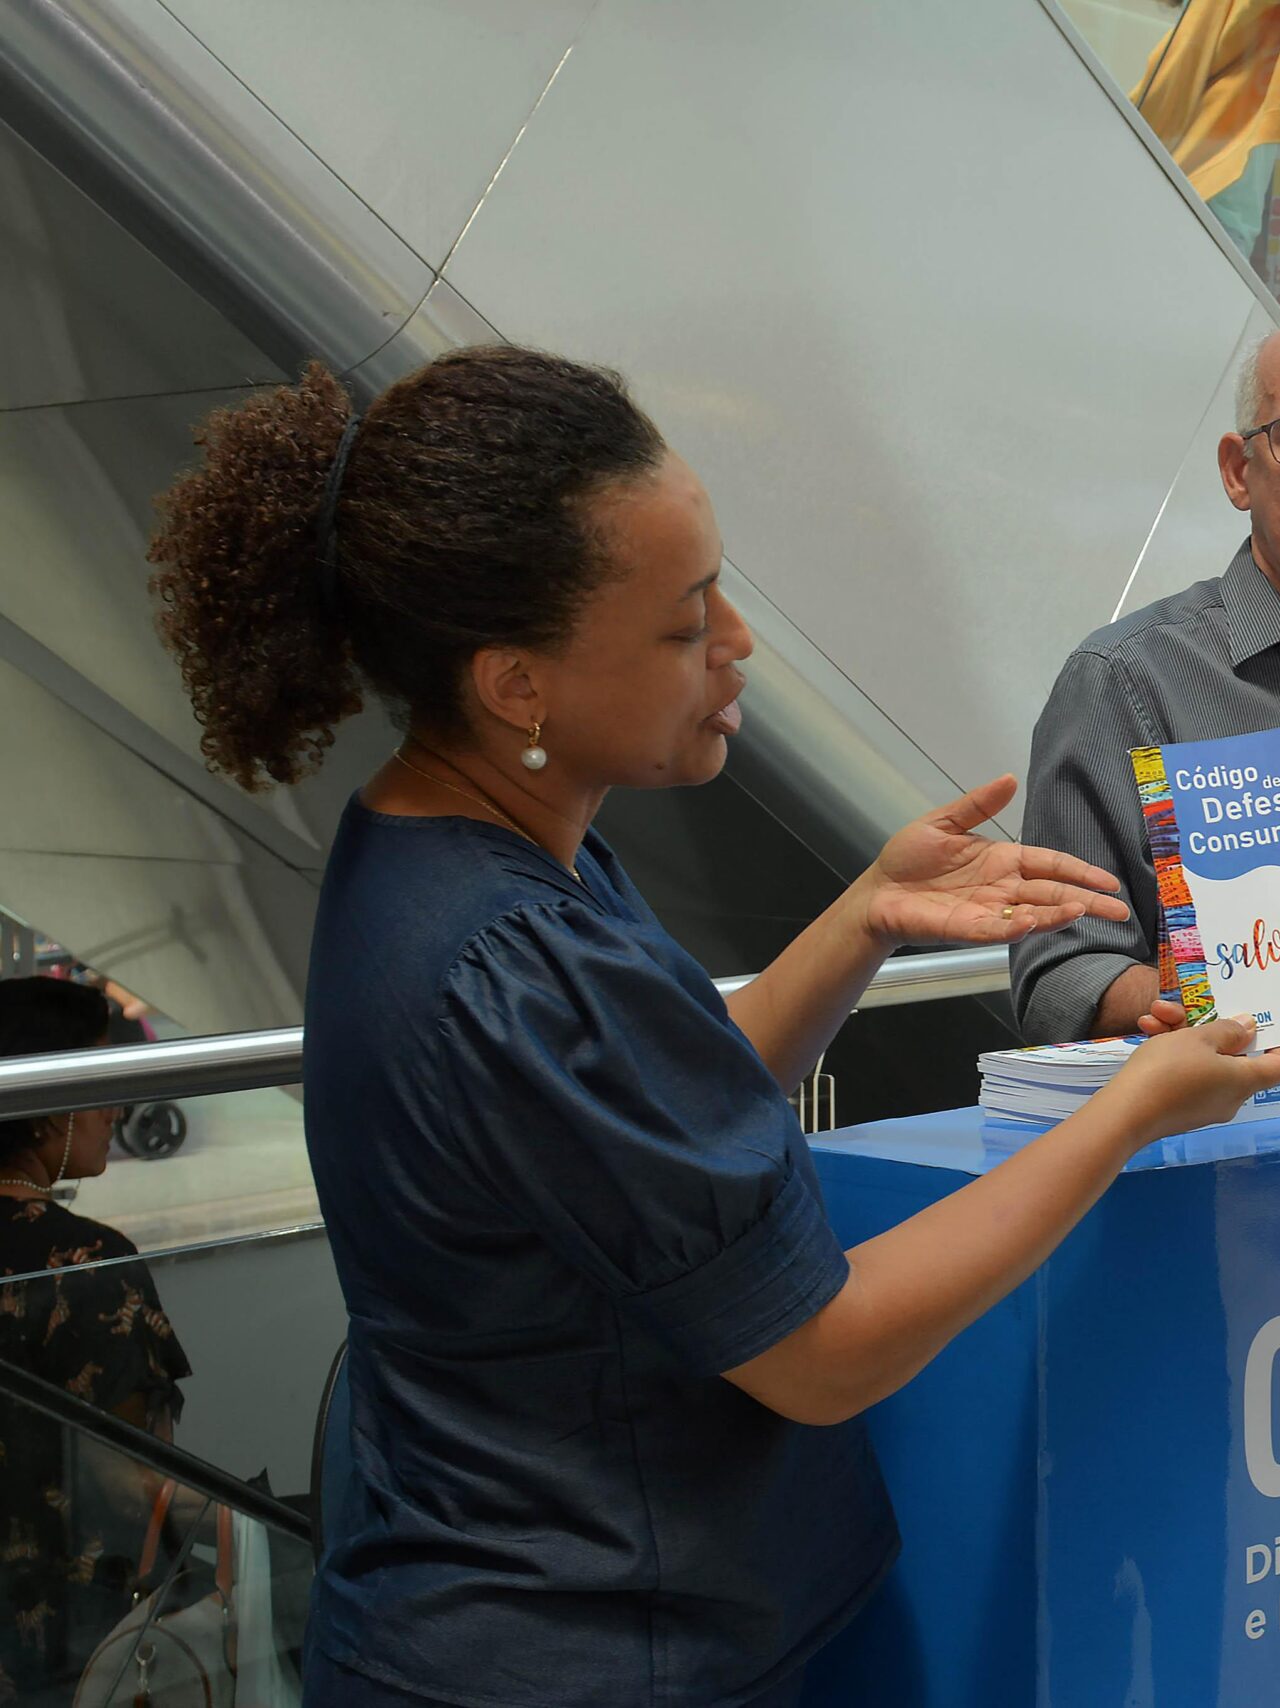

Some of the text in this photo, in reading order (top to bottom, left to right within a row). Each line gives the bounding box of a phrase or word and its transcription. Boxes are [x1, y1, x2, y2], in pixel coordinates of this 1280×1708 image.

[1175, 766, 1258, 791] Código
[1252, 1011, 1272, 1024] ON
[1244, 1608, 1266, 1640] e
